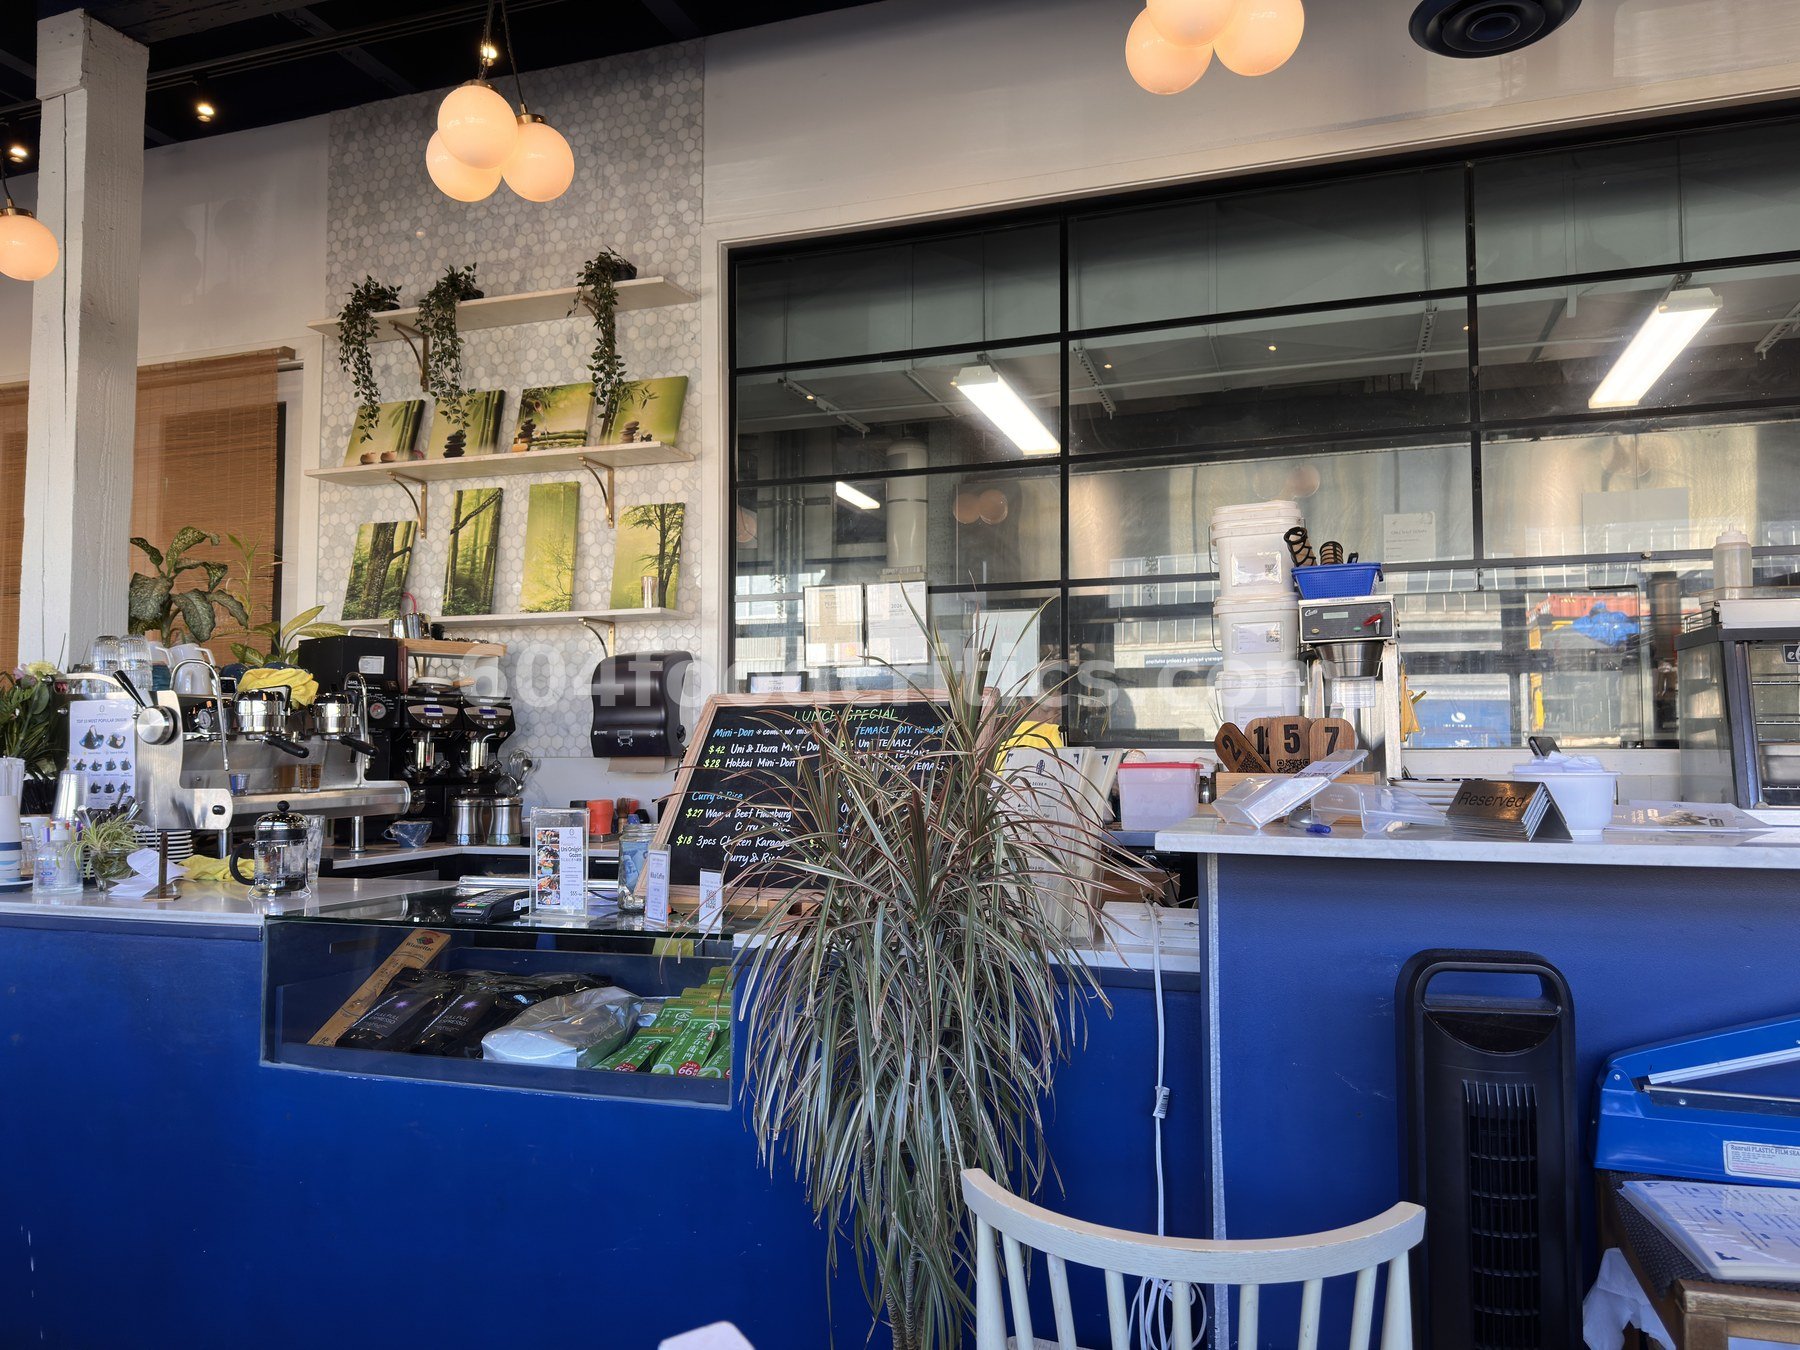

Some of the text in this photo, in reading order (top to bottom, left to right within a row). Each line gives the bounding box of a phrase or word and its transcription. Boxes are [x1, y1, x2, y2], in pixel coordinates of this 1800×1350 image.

[794, 708, 899, 722] LUNCH SPECIAL
[713, 728, 754, 738] Mini-Don
[855, 726, 890, 735] TEMAKI
[899, 726, 912, 734] DIY
[1283, 723, 1300, 753] 5
[1325, 726, 1339, 756] 7
[708, 745, 726, 754] $42
[730, 744, 745, 754] Uni
[746, 745, 754, 753] &
[754, 743, 779, 753] Ikura
[1221, 734, 1242, 761] 2
[703, 758, 796, 768] $28 Hokkai Mini-Don
[691, 791, 715, 804] Curry
[1458, 791, 1526, 807] Reserved
[686, 807, 703, 818] $27
[734, 807, 755, 818] Beef
[676, 834, 693, 846] $18
[696, 835, 716, 848] 3pcs
[720, 835, 752, 847] Chken
[724, 853, 749, 867] Curry
[750, 853, 759, 863] &
[678, 1067, 693, 1076] 66
[1751, 1146, 1774, 1154] PLASTIC
[1774, 1148, 1789, 1156] FILM
